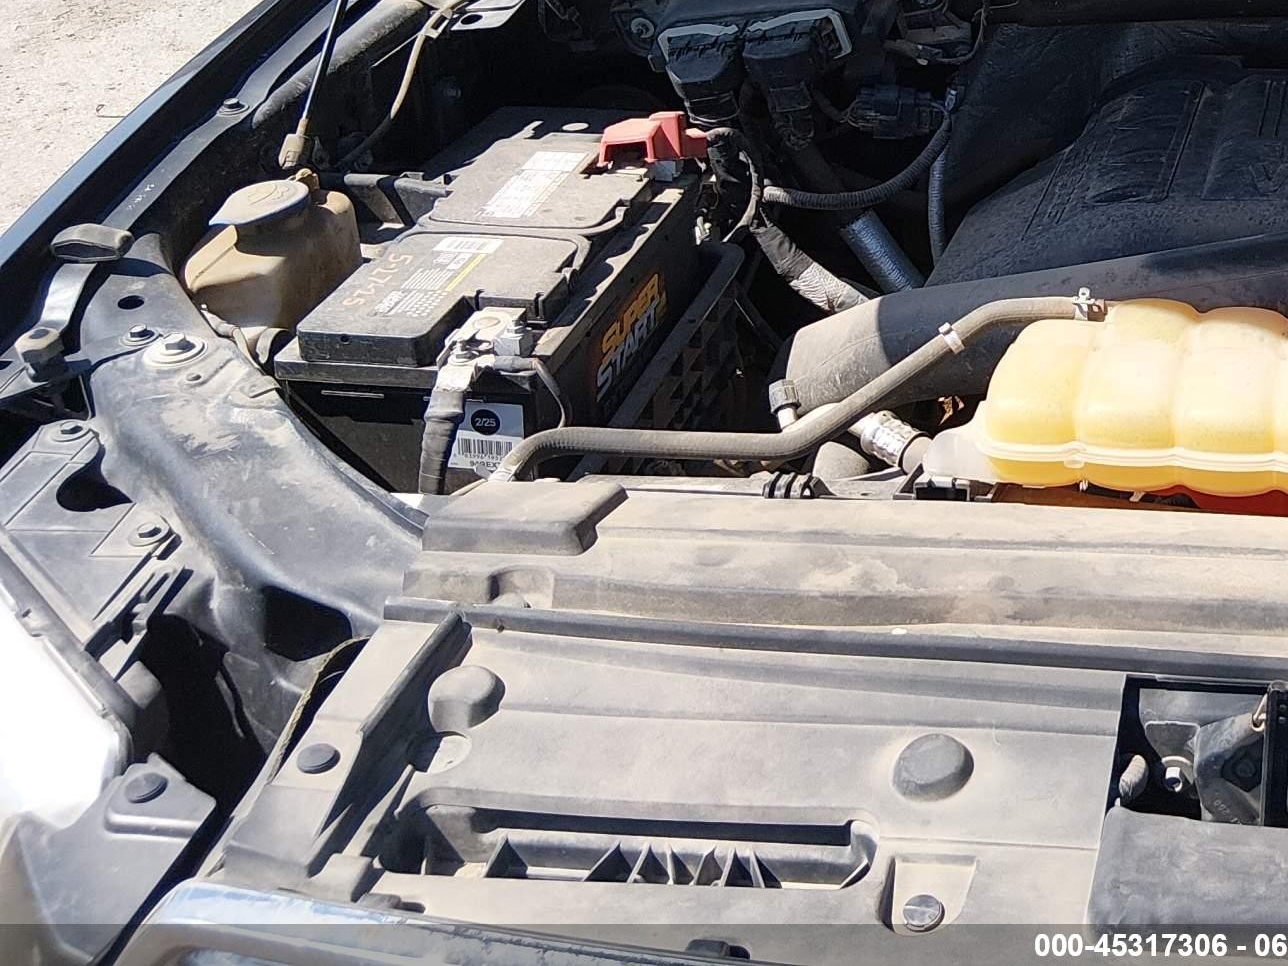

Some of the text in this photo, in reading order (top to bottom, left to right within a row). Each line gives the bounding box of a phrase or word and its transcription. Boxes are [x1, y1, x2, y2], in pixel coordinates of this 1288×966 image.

[596, 295, 661, 403] START
[601, 273, 660, 354] SUPER
[474, 417, 497, 427] 2/25
